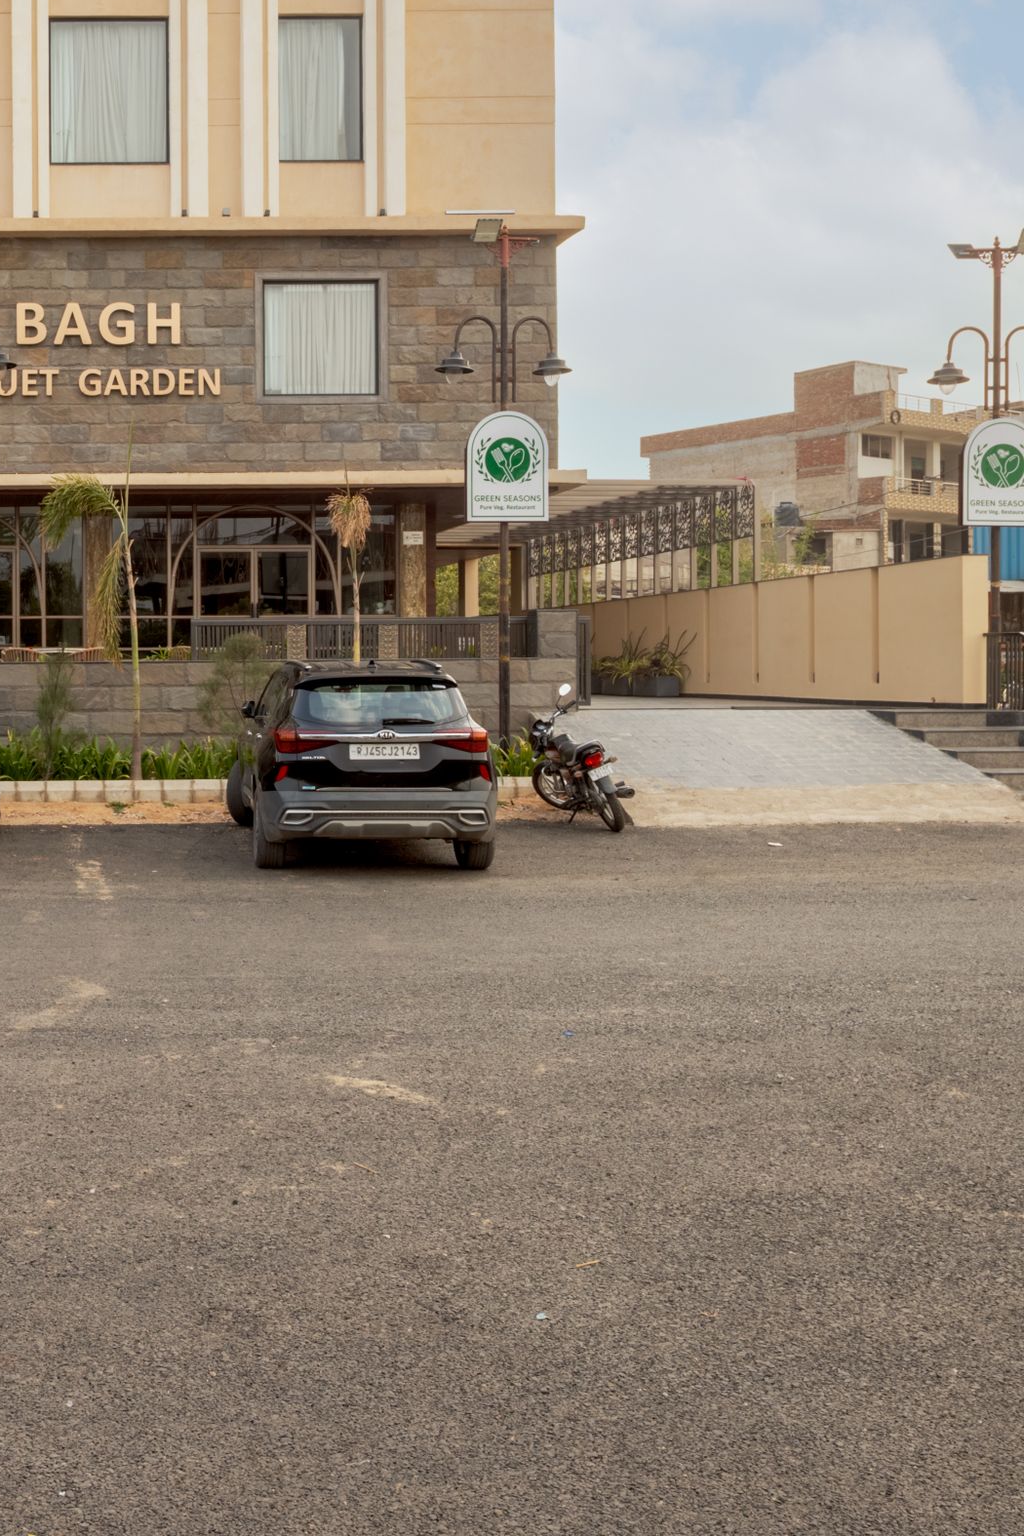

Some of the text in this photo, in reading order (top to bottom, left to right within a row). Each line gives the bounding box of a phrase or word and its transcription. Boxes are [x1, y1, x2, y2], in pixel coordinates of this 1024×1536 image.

[15, 301, 182, 346] BAGH
[78, 368, 221, 397] GARDEN
[474, 494, 542, 502] GREEN SEASONS
[970, 499, 996, 507] GREEN
